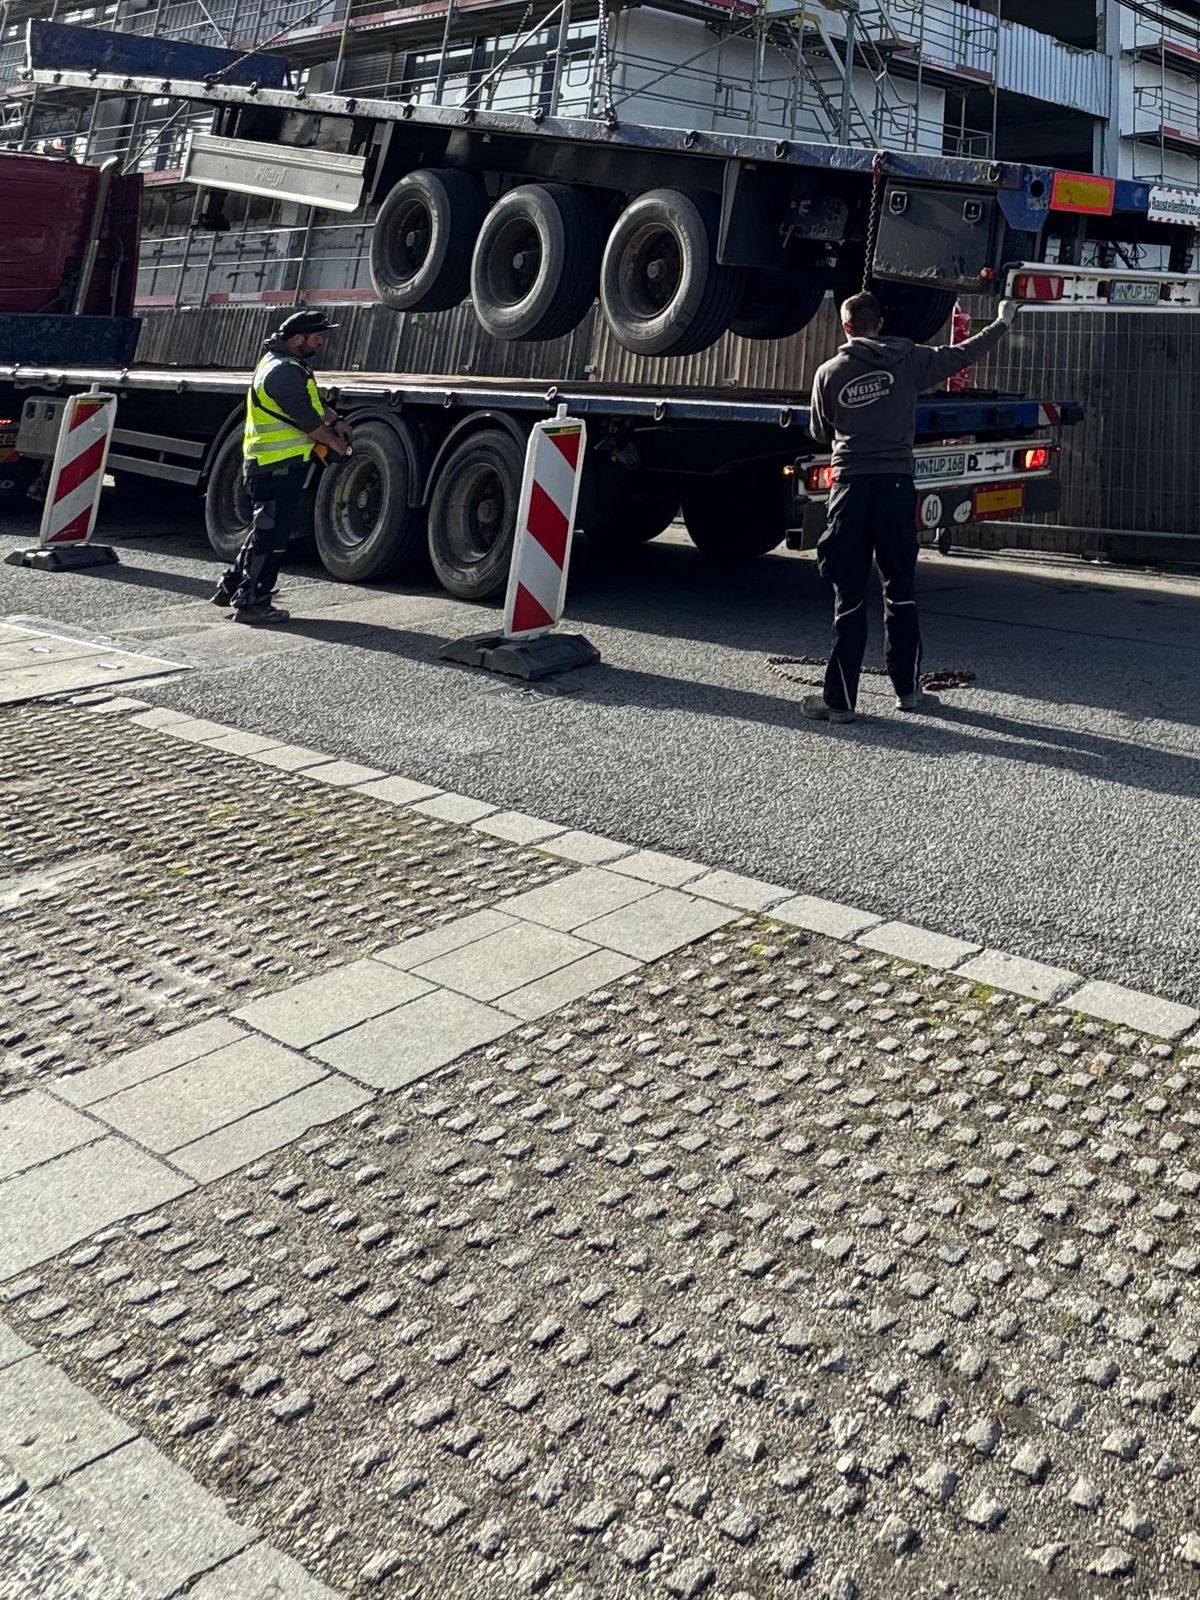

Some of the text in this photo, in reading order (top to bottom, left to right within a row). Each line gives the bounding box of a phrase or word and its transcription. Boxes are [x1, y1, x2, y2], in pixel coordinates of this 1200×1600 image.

[846, 382, 880, 398] WEISS
[916, 456, 963, 474] MN UP 168
[925, 500, 939, 522] 60
